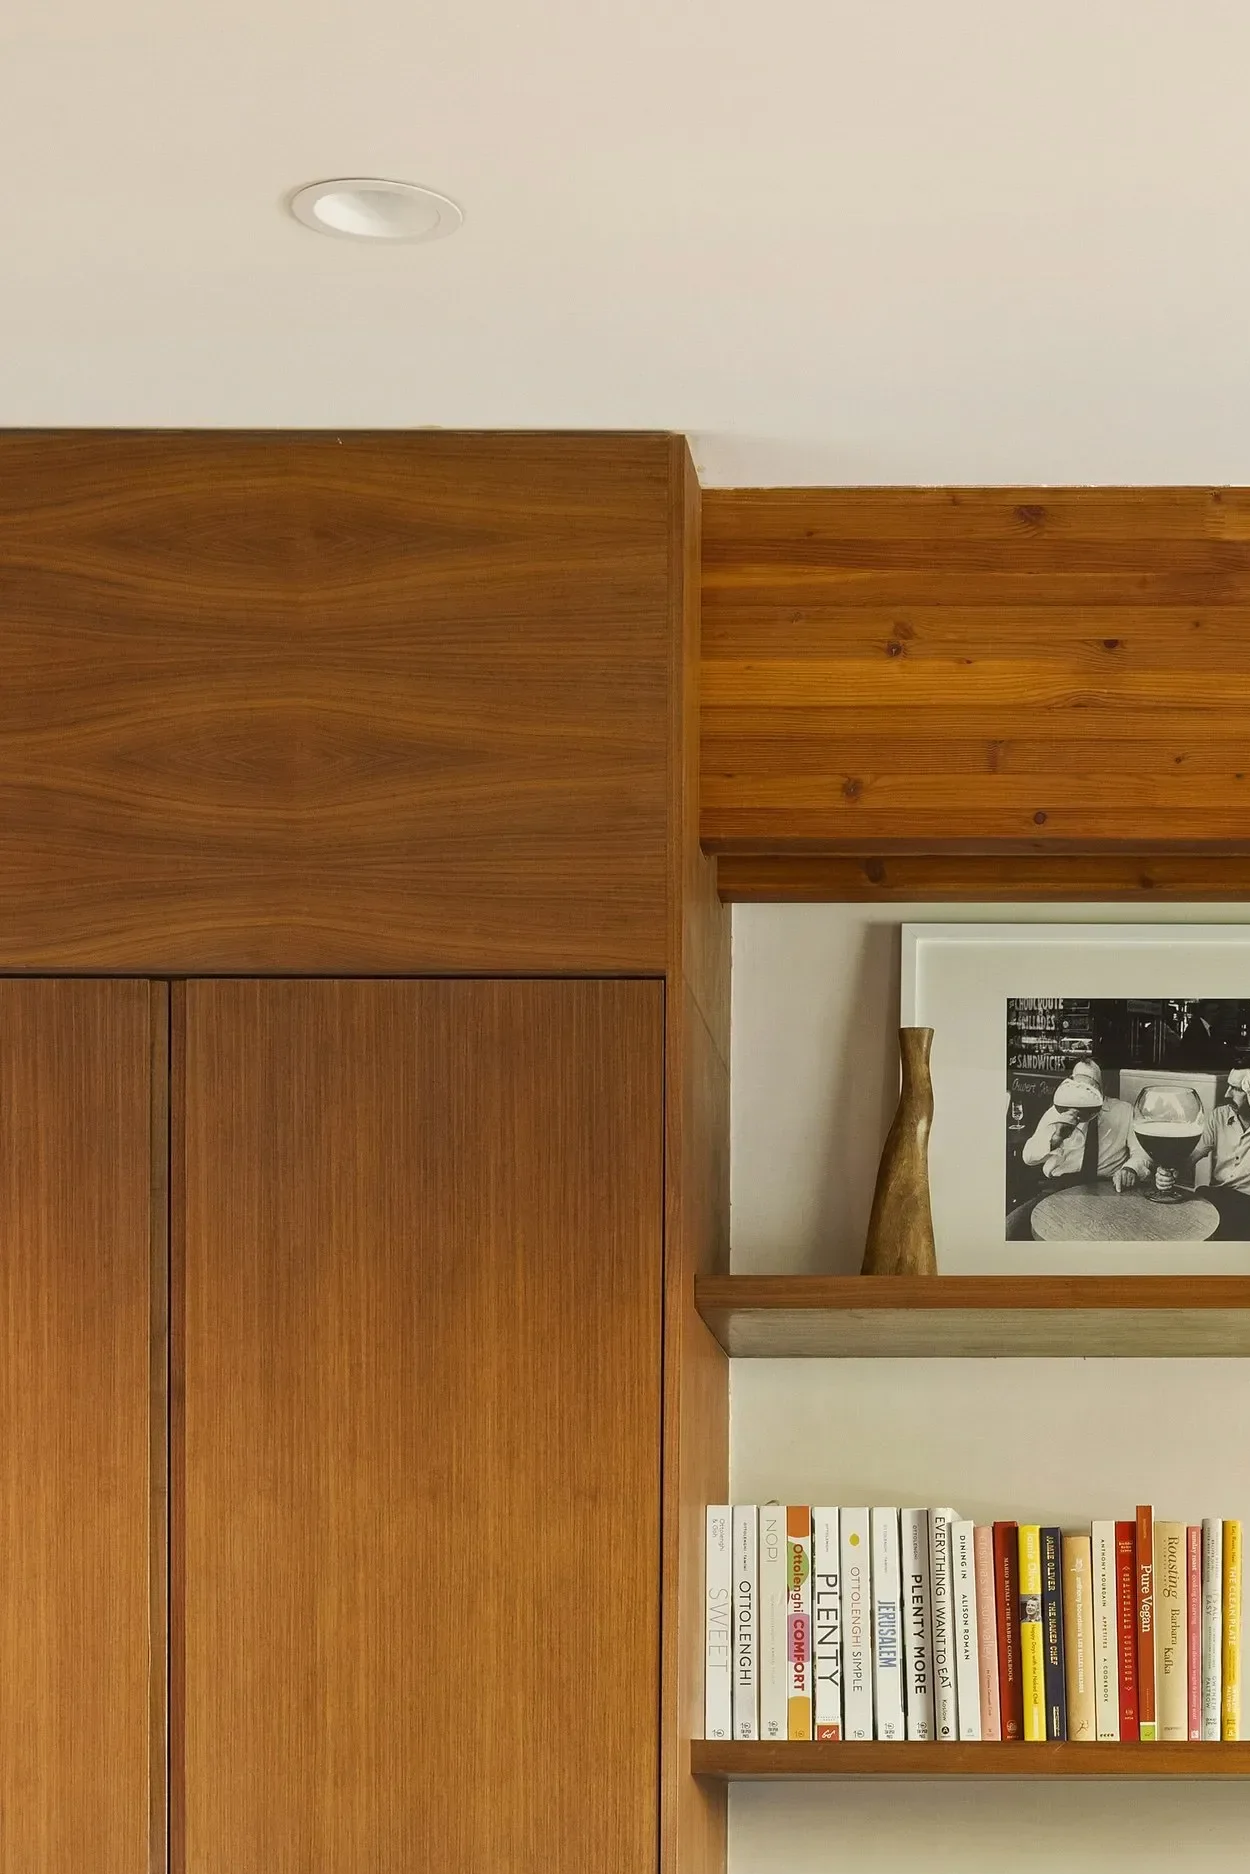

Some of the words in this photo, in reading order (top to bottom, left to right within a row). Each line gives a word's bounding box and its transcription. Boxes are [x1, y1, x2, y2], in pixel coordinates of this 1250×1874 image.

[766, 1519, 778, 1563] NOPI
[935, 1517, 945, 1596] EVERYTHING
[1046, 1536, 1055, 1560] JAMIE
[791, 1544, 804, 1613] Ottolenghi
[961, 1570, 968, 1579] IN
[1047, 1562, 1056, 1591] OLIVER
[1140, 1564, 1152, 1593] Pure
[1163, 1537, 1180, 1599] Roasting
[851, 1567, 861, 1648] OTTOLENGHI
[911, 1575, 924, 1639] PLENTY
[961, 1594, 969, 1626] ALISON
[1049, 1602, 1057, 1616] THE
[1139, 1595, 1153, 1632] Vegan
[1228, 1586, 1236, 1615] CLEAN
[708, 1588, 729, 1673] SWEET
[739, 1581, 752, 1686] OTTOLENGHI
[817, 1574, 838, 1687] PLENTY
[877, 1600, 897, 1668] JERUSALEM
[936, 1607, 946, 1645] WANT
[1049, 1618, 1057, 1643] NAKED
[1170, 1609, 1180, 1645] Barbara
[1228, 1618, 1236, 1646] PLATE
[793, 1620, 805, 1691] COMFORT
[853, 1652, 863, 1692] SIMPLE
[914, 1647, 927, 1695] MORE
[936, 1648, 946, 1665] TO
[1050, 1646, 1058, 1666] CHEF
[1163, 1647, 1174, 1674] Kafka
[938, 1668, 951, 1689] EAT
